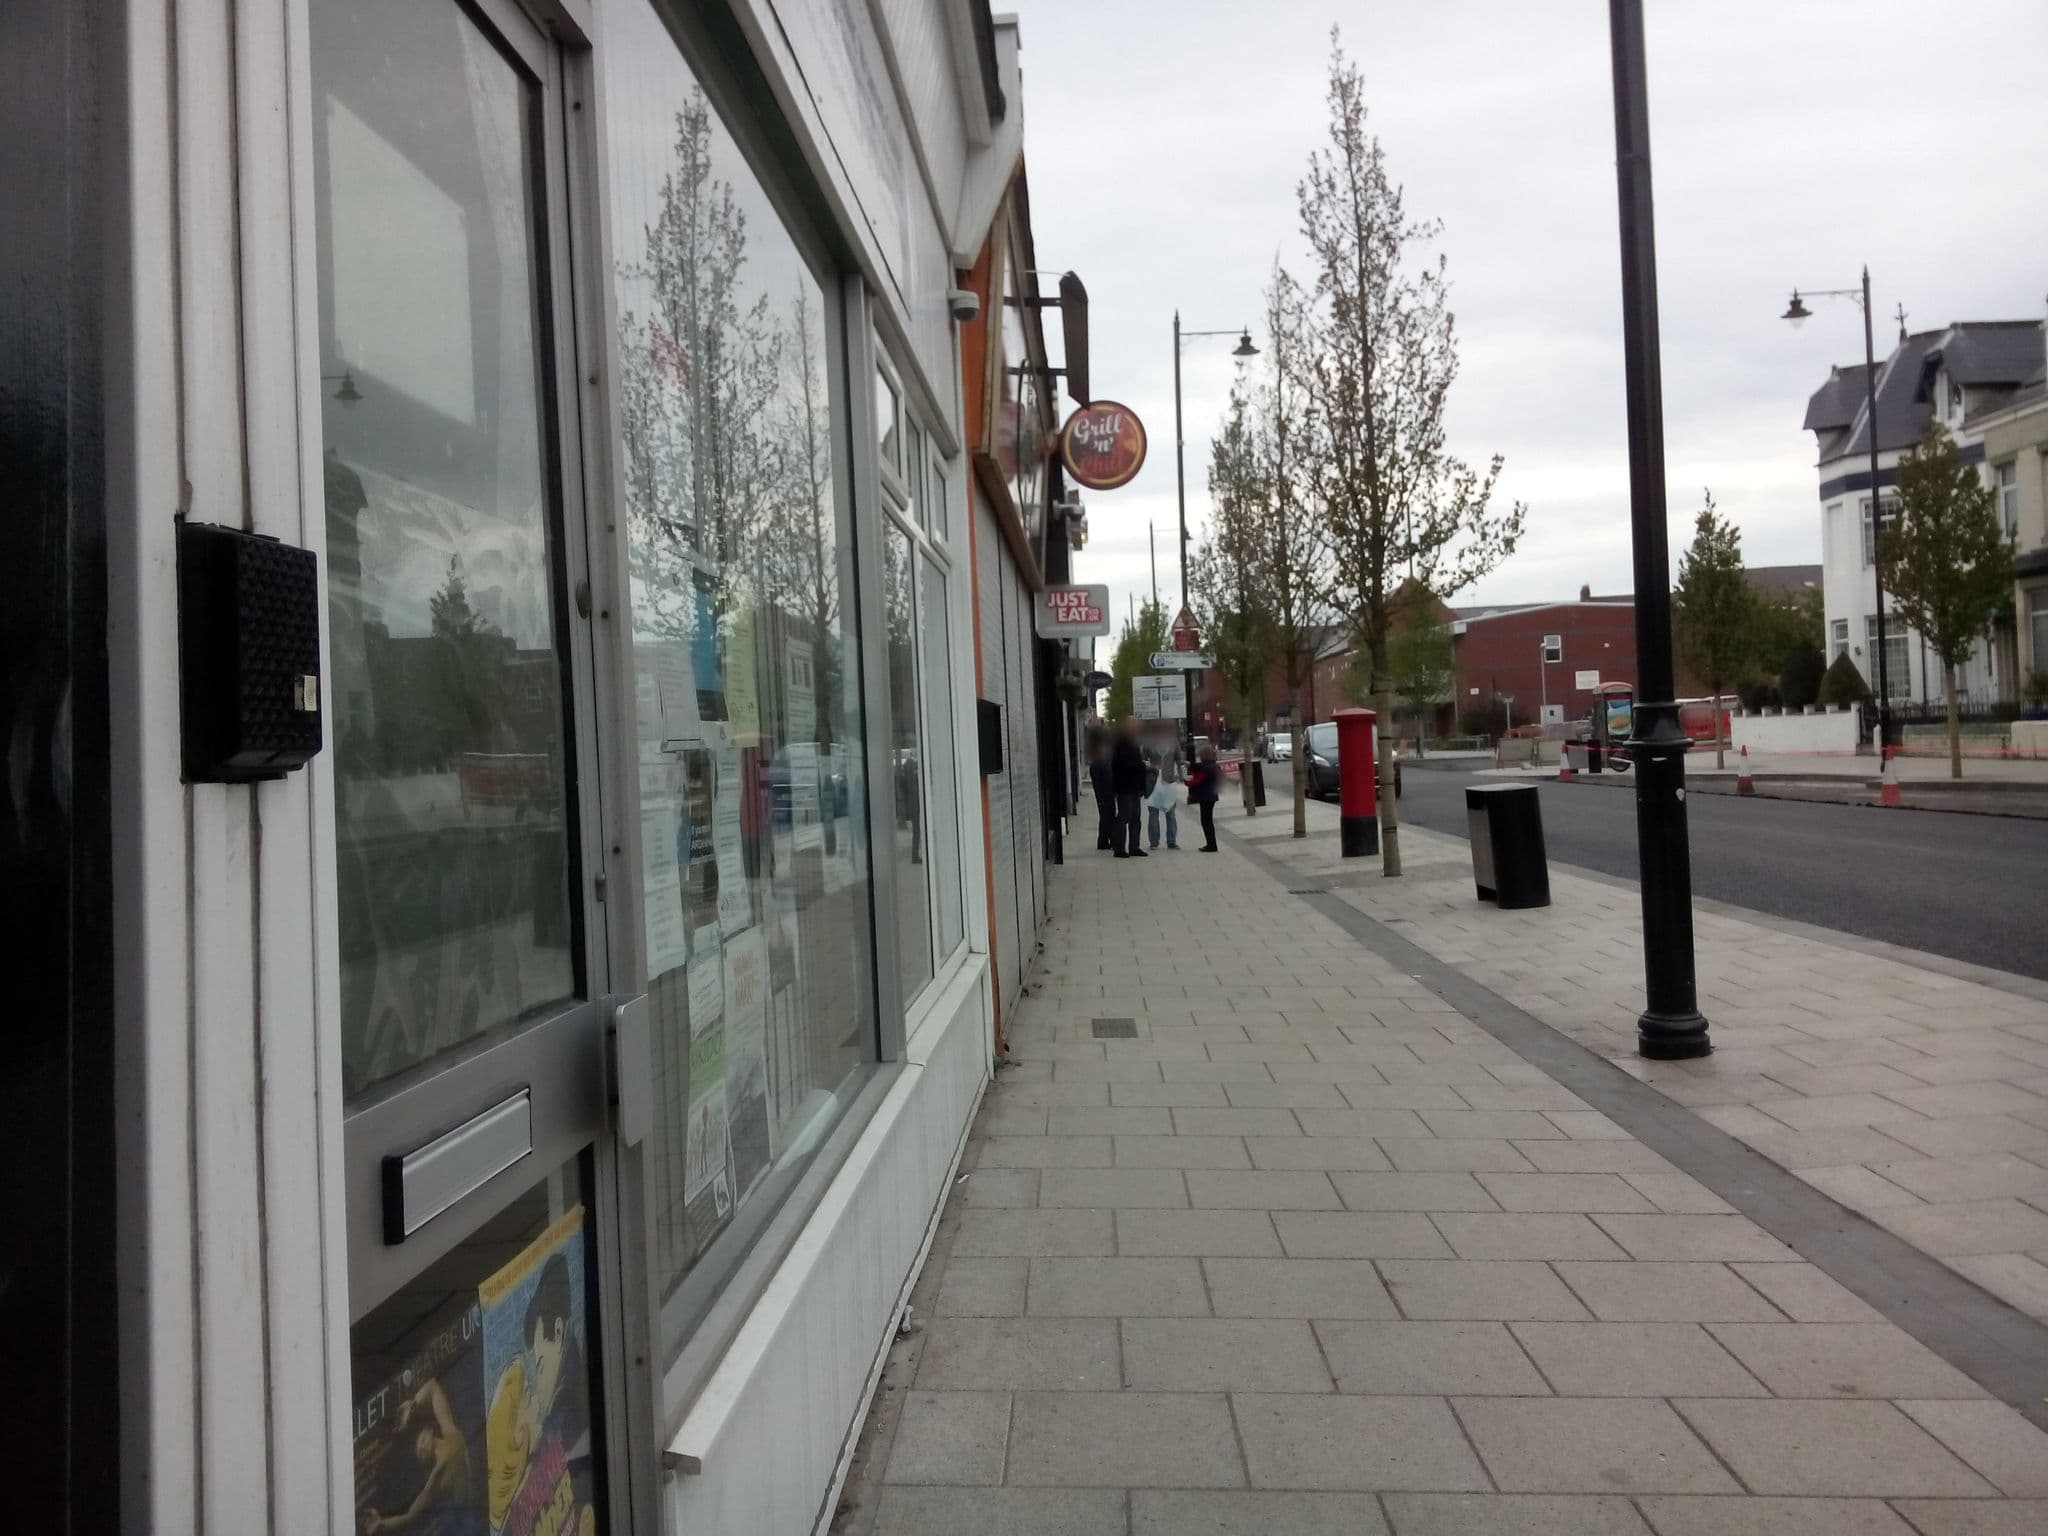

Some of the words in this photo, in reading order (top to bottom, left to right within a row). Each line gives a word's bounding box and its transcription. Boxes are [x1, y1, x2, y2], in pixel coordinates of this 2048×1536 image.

[1073, 412, 1122, 445] Grill
[1047, 591, 1089, 607] JUST
[1058, 607, 1089, 622] EAT
